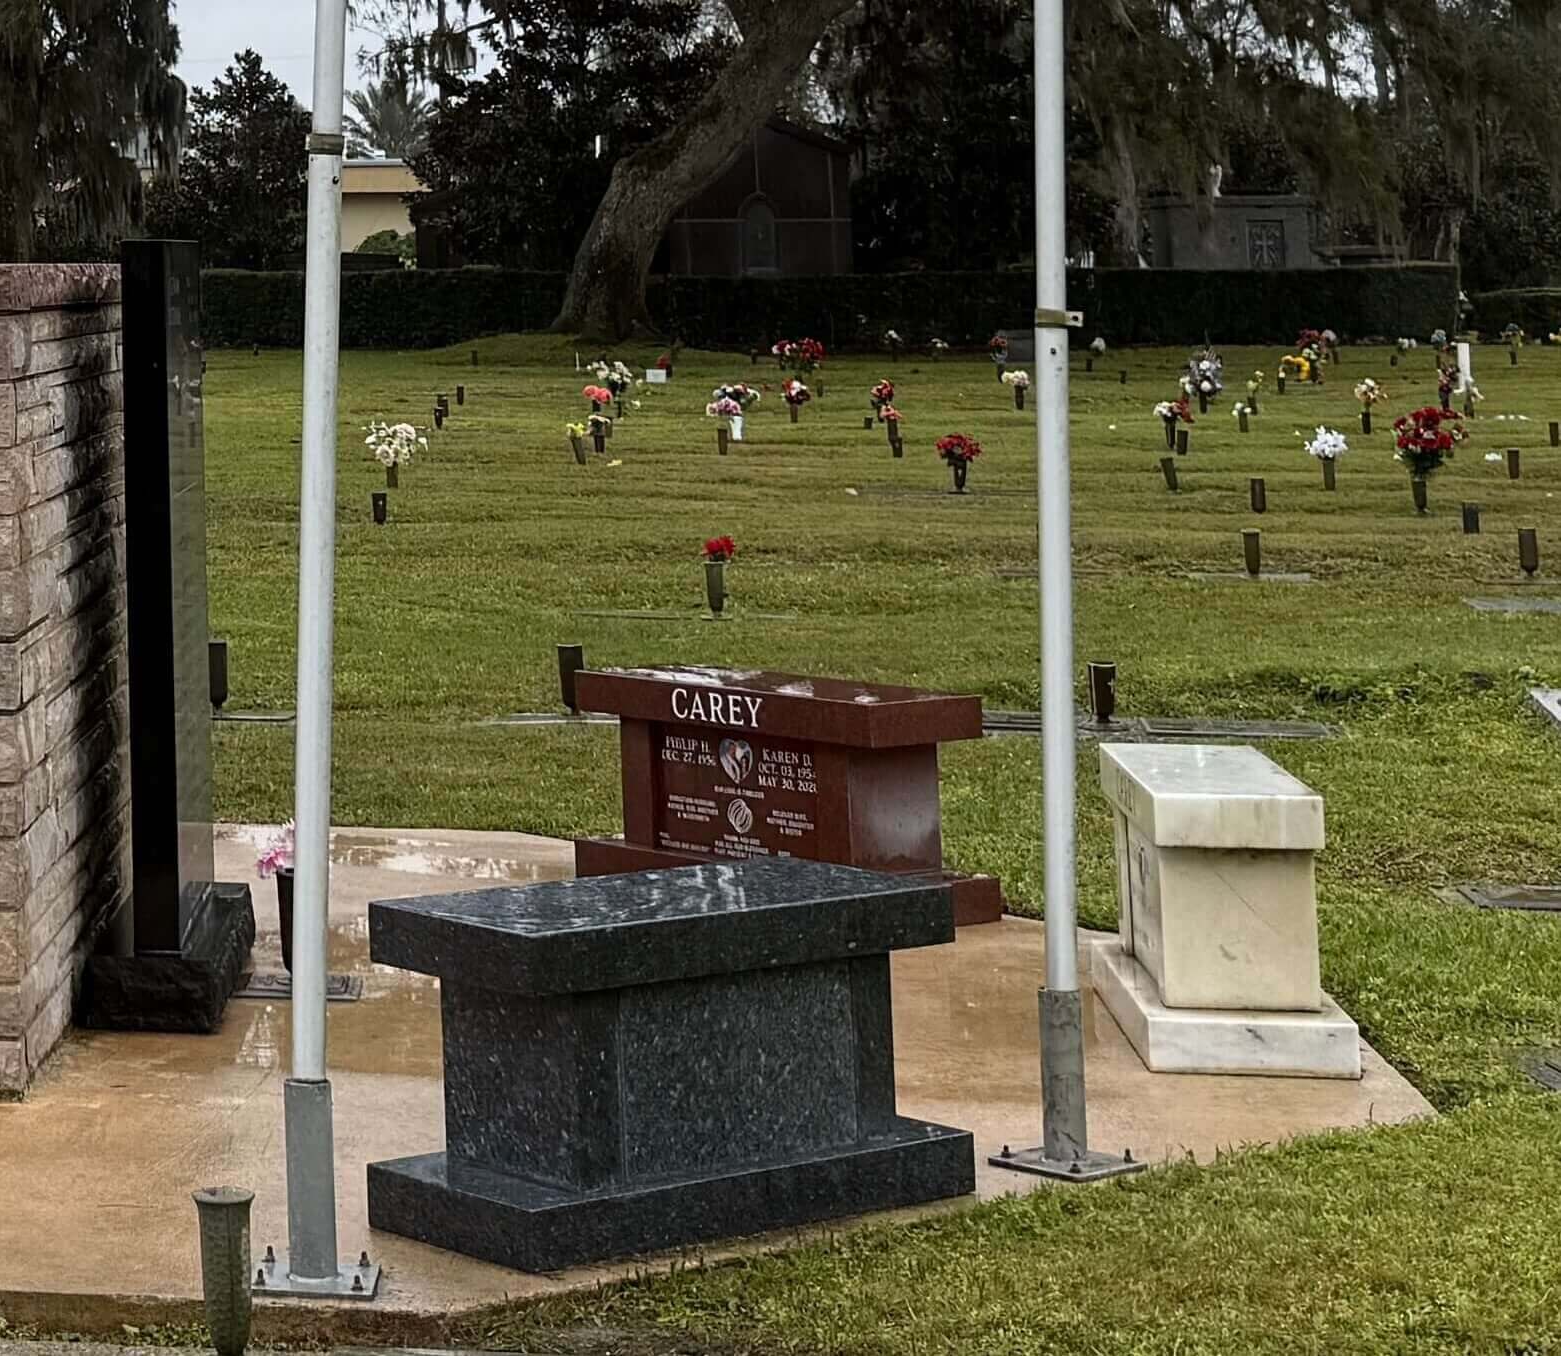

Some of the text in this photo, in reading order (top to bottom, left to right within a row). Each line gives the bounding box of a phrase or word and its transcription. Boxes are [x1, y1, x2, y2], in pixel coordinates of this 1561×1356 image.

[671, 687, 763, 728] CAREY
[762, 747, 799, 764] KAREN
[758, 775, 778, 788] MAY
